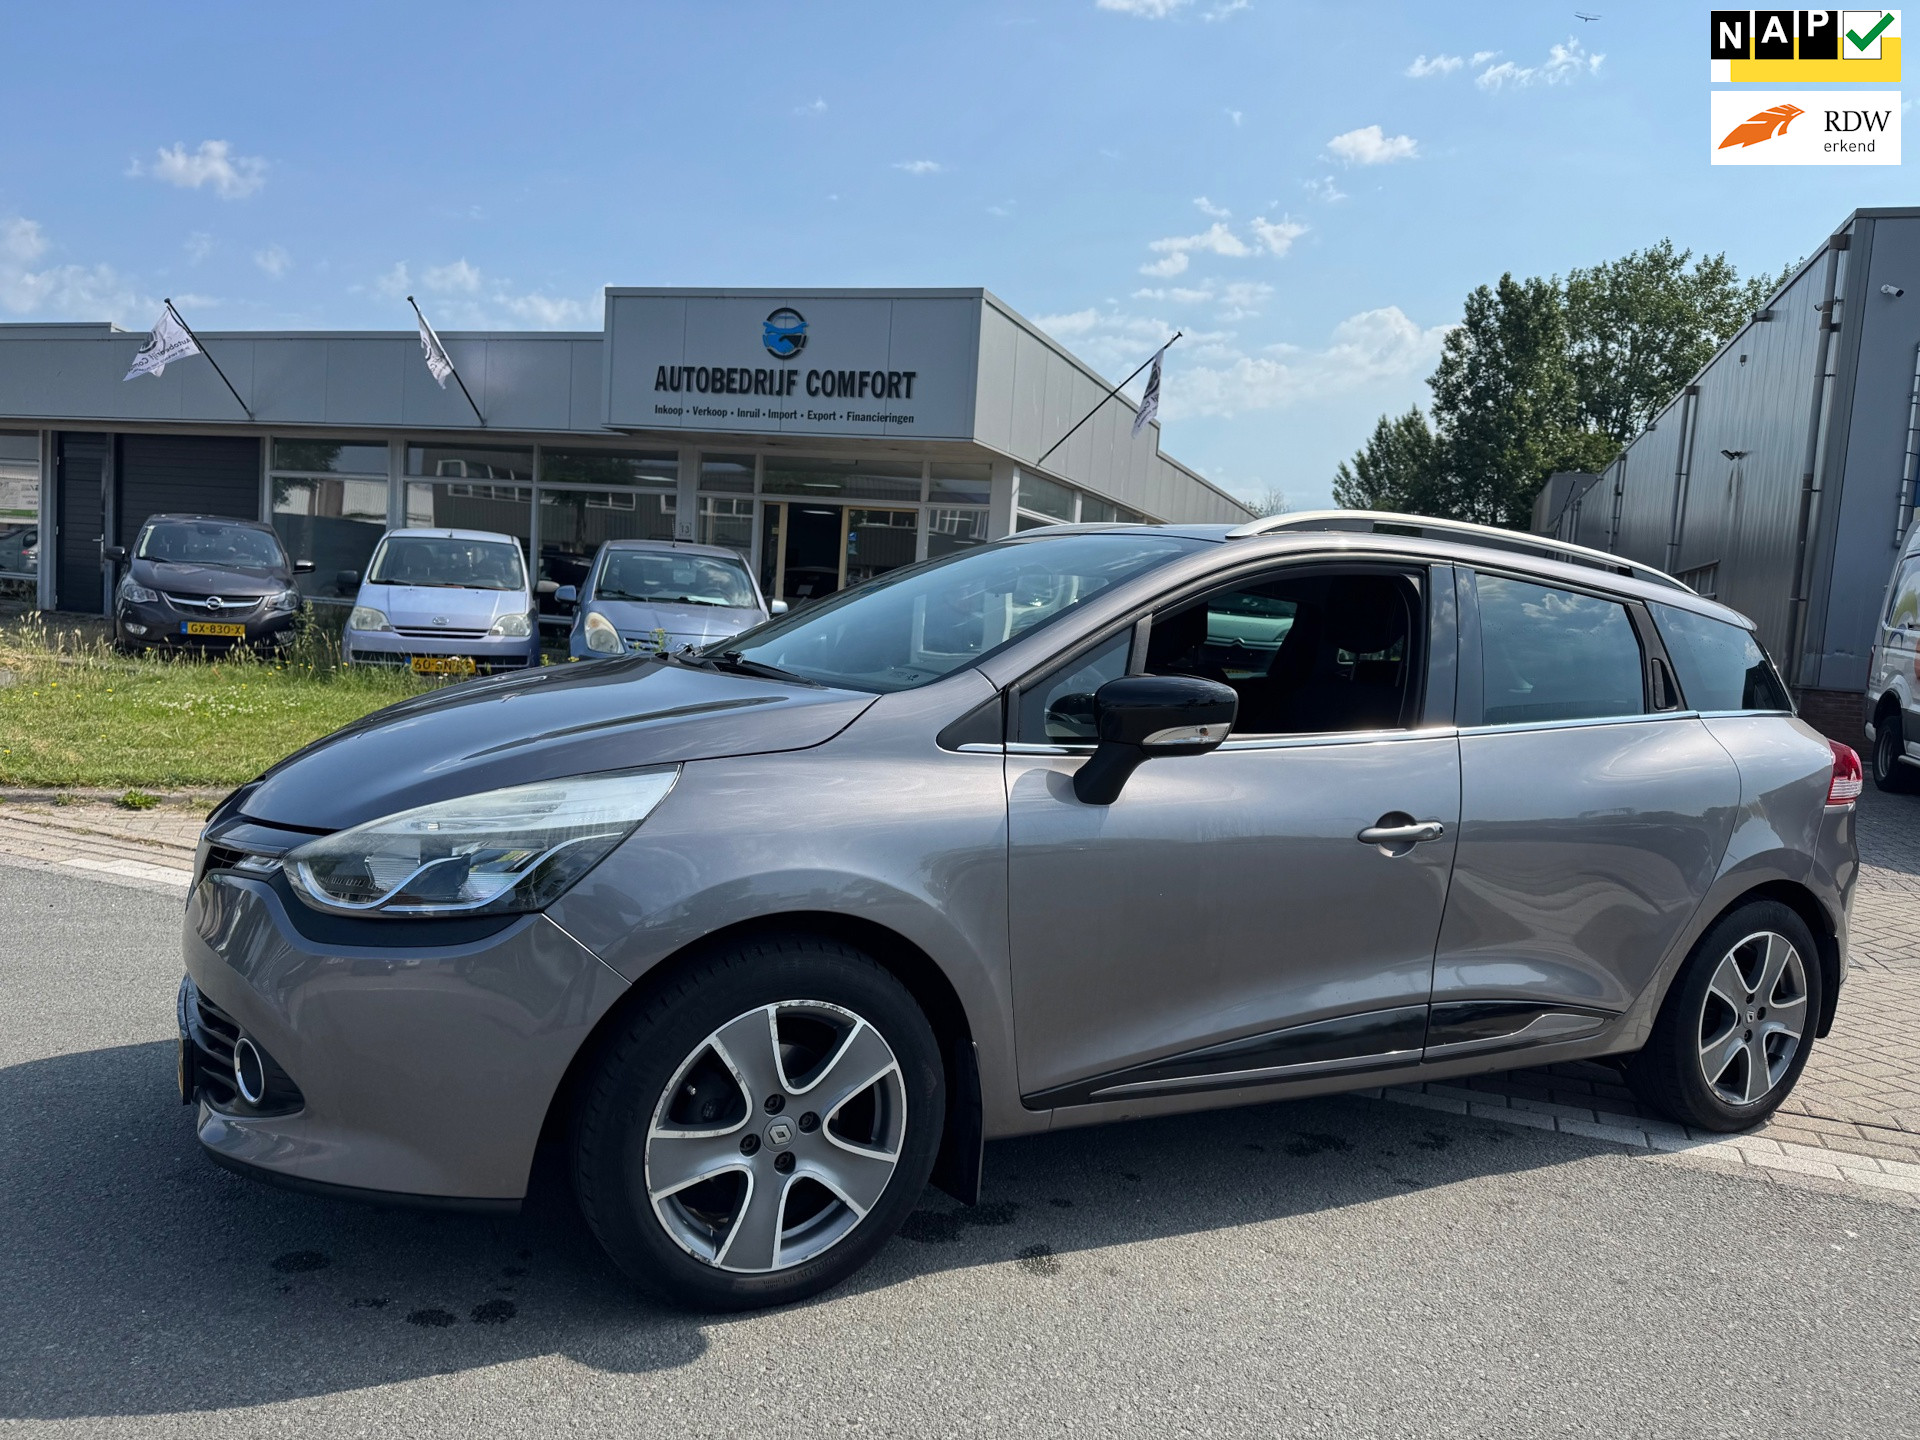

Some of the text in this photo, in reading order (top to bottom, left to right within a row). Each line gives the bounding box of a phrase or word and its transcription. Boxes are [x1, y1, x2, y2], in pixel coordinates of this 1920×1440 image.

[654, 365, 917, 399] AUTOBEDRIJF COMFORT
[654, 404, 915, 425] Inkoop Verkoop Inruil Import Export Financieringen
